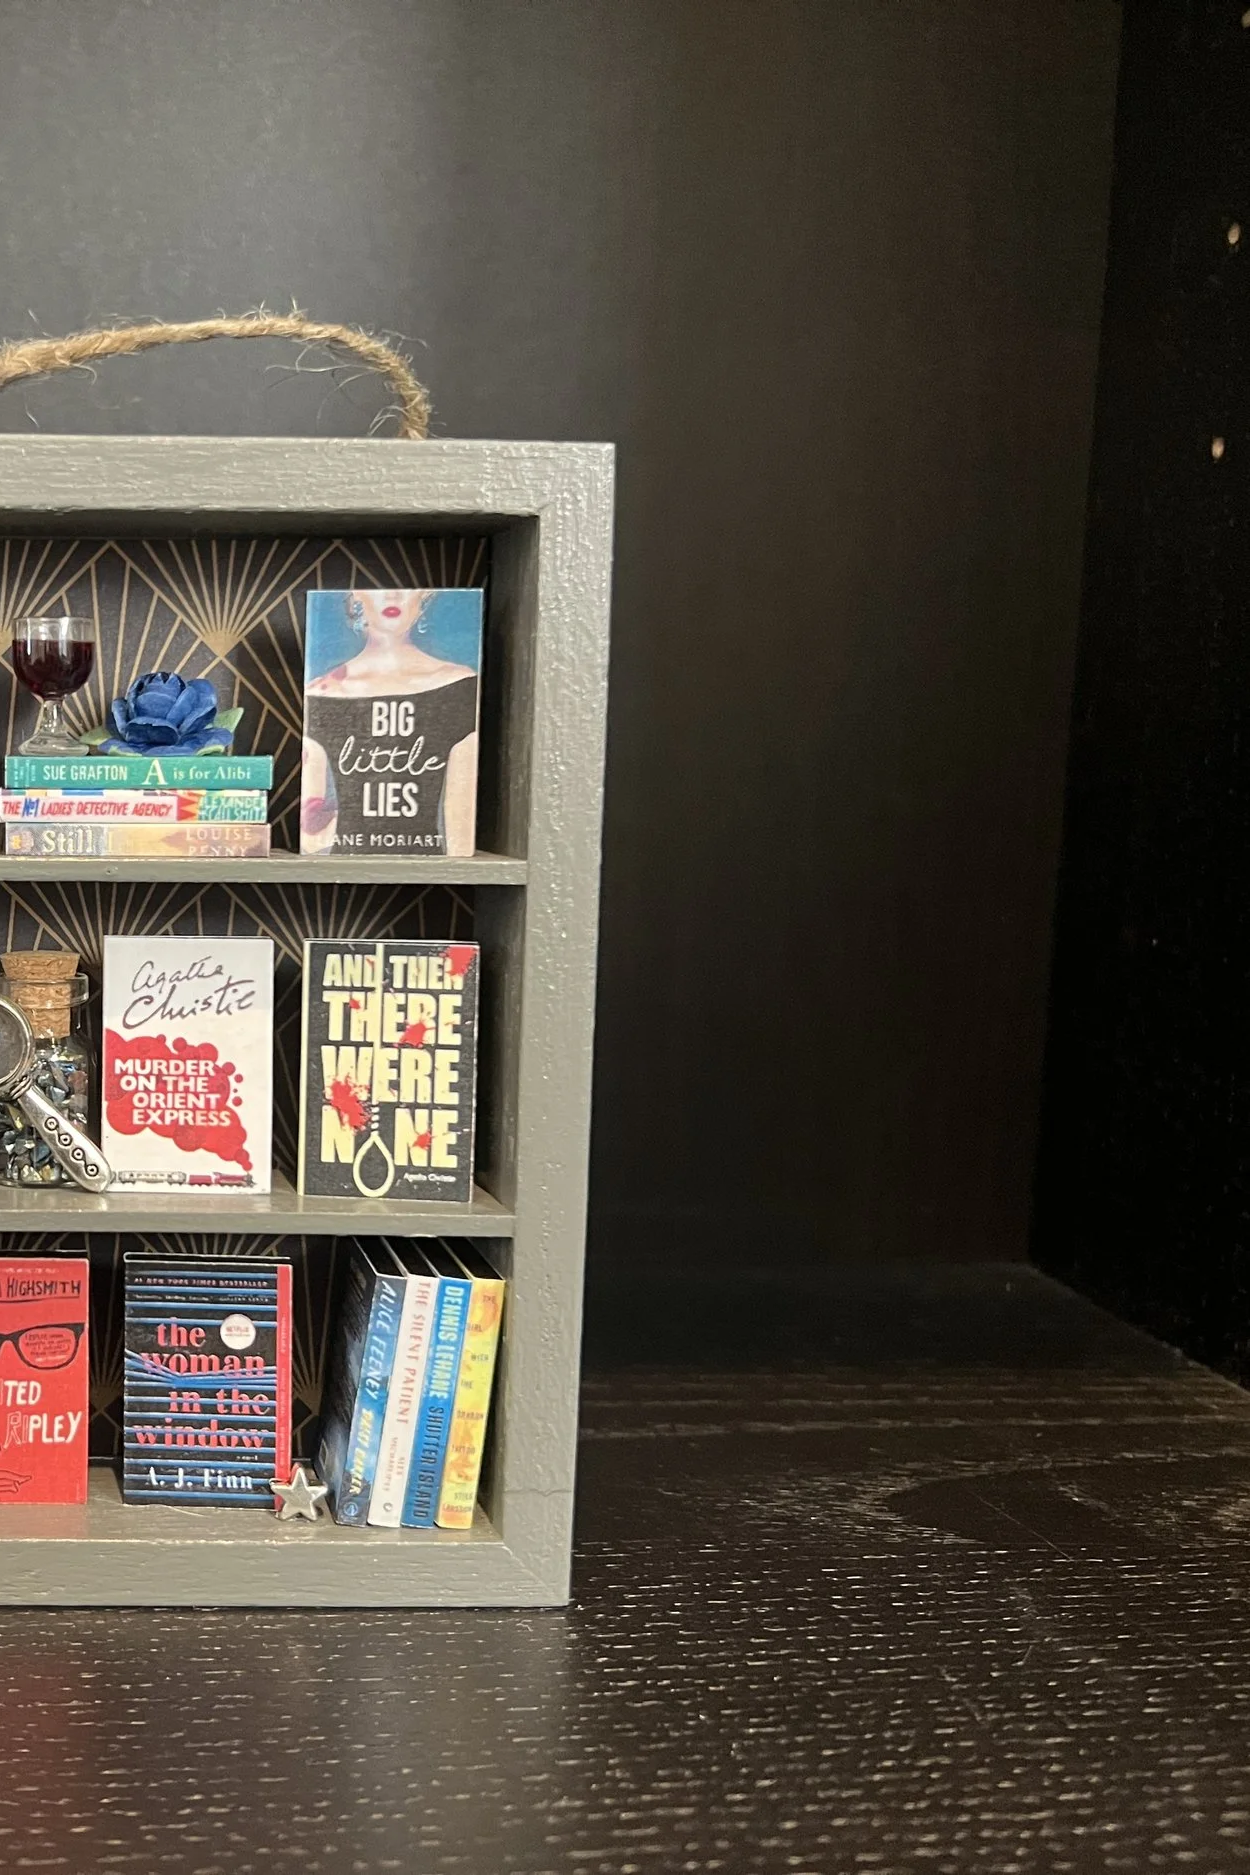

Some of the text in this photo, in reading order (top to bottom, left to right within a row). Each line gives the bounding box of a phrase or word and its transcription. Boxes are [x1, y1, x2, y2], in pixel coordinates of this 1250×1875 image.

[372, 701, 415, 738] BIG
[43, 765, 66, 780] SUE
[70, 765, 128, 780] GRAFTON
[142, 758, 168, 786] A
[173, 767, 184, 780] is
[189, 766, 210, 780] for
[214, 766, 250, 780] Alibi
[338, 736, 446, 776] little
[2, 801, 22, 815] THE
[76, 802, 130, 816] DETECTIVE
[132, 803, 173, 818] AGENCY
[362, 782, 418, 818] LIES
[42, 830, 94, 854] Still
[186, 828, 252, 840] LOUISE
[370, 834, 444, 847] MORIART
[131, 956, 224, 994] Agatha
[322, 954, 378, 988] AND
[122, 976, 256, 1030] Christie
[322, 990, 462, 1046] THERE
[114, 1059, 215, 1076] MURDER
[320, 1046, 460, 1106] WERE
[120, 1076, 209, 1092] ON THE
[132, 1092, 222, 1110] ORIENT
[132, 1108, 232, 1126] EXPRESS
[320, 1104, 459, 1197] NONE
[6, 1277, 82, 1298] HIGHSMITH
[376, 1280, 397, 1334] ALICE
[157, 1316, 206, 1348] the
[140, 1352, 266, 1378] woman
[364, 1335, 386, 1400] FEENEY
[396, 1282, 430, 1425] THE SILENT PATIENT
[168, 1384, 271, 1416] in the
[413, 1285, 464, 1519] DENNIS LEHANE SHUTTER ISLAND
[4, 1410, 82, 1449] RIPLEY
[132, 1418, 269, 1448] window
[174, 1467, 193, 1490] J.
[204, 1469, 253, 1490] Finn
